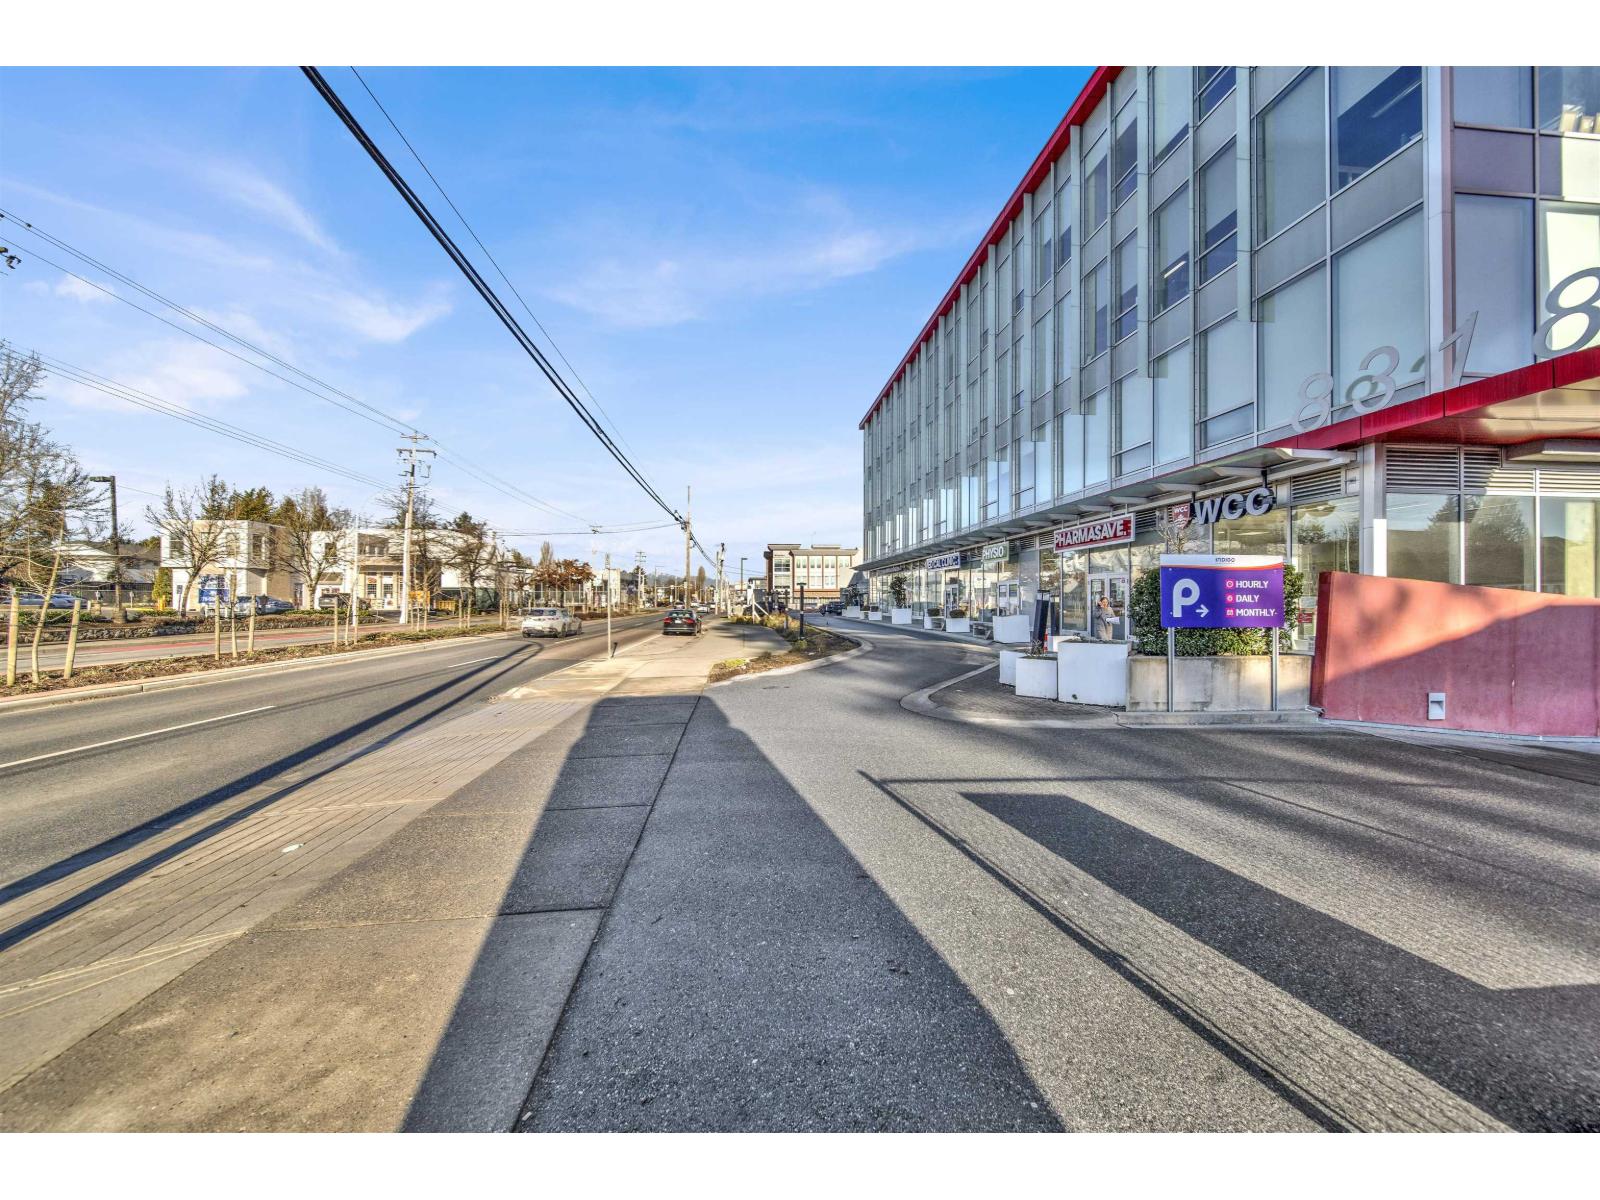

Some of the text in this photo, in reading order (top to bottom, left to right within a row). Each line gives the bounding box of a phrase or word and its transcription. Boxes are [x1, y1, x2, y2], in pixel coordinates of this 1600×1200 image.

[1174, 505, 1188, 513] WCC
[1194, 487, 1272, 525] WCC
[982, 545, 1004, 560] PHYSIO
[1235, 580, 1269, 589] HOURLY
[1173, 578, 1200, 618] P
[1235, 594, 1260, 603] DAILY
[1235, 608, 1275, 617] MONTHLY
